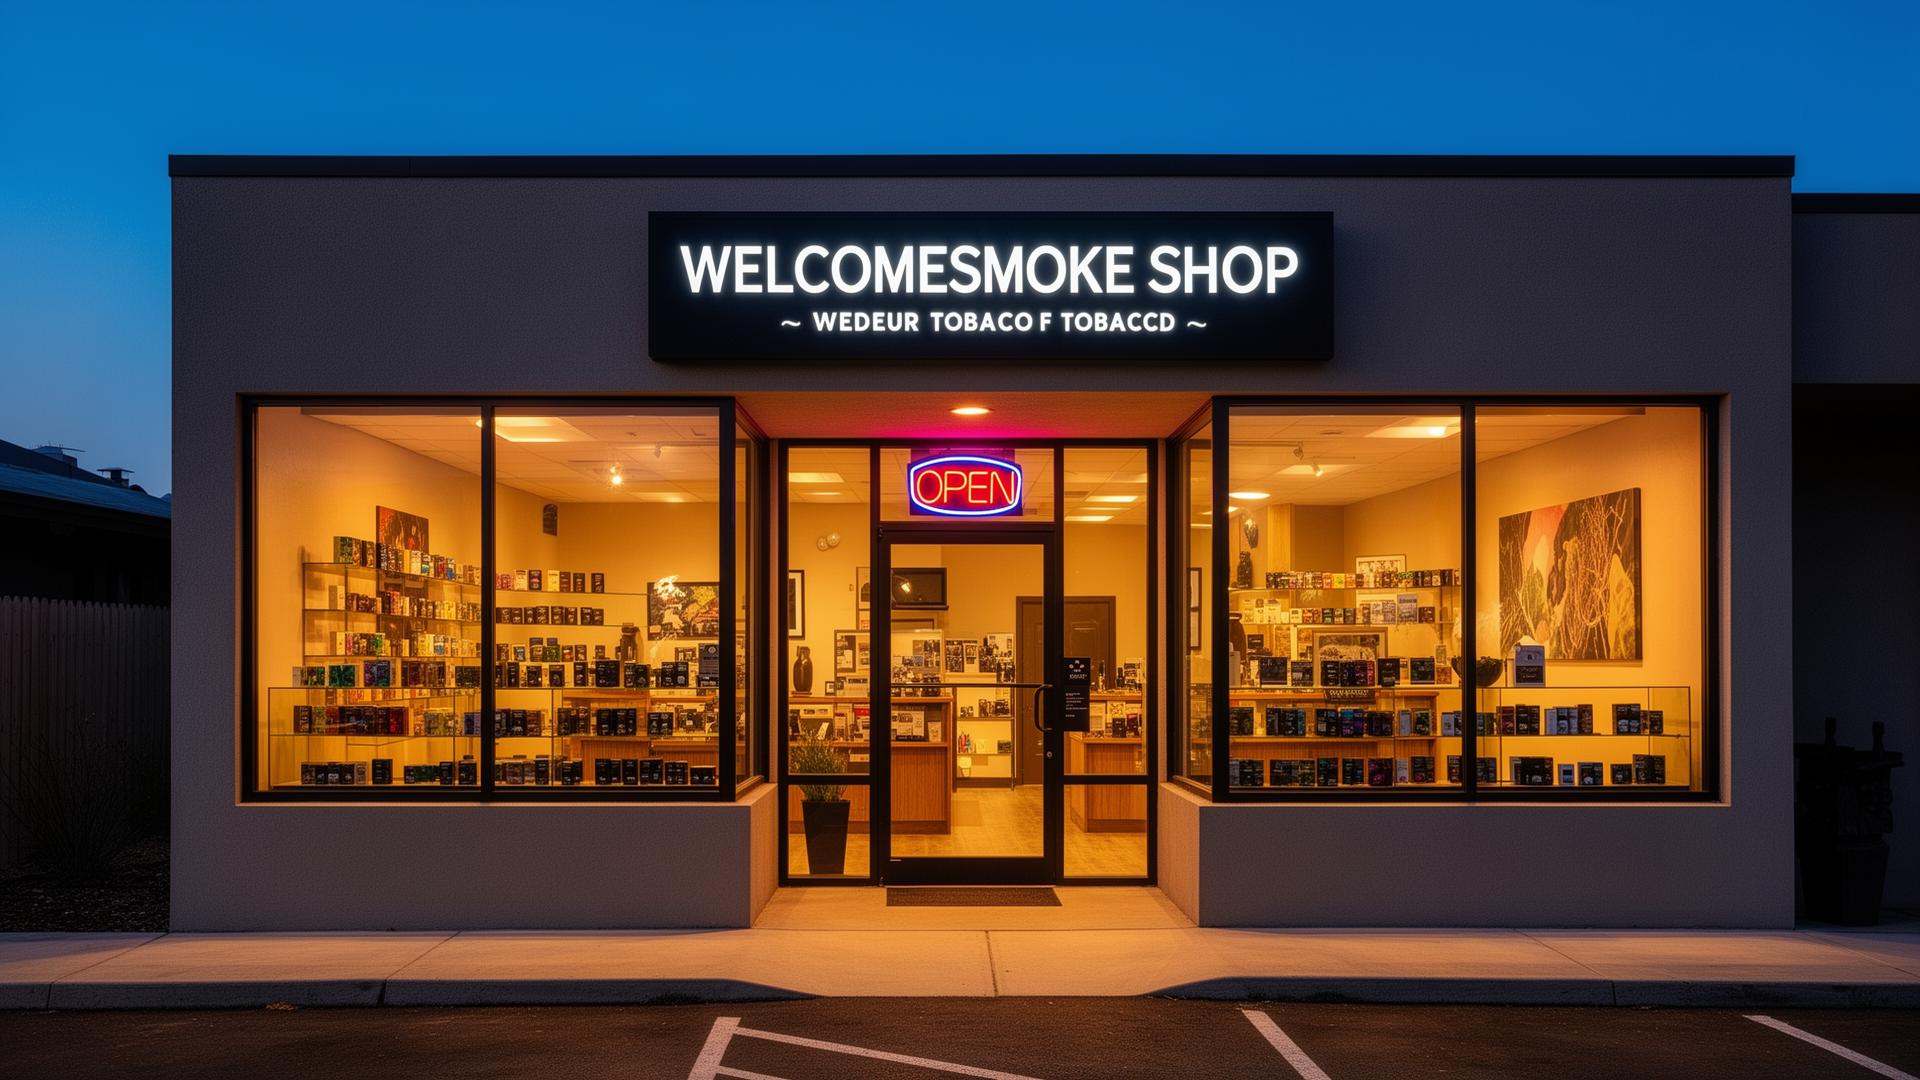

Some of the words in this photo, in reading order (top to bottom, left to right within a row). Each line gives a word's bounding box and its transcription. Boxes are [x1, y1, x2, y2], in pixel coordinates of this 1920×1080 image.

[680, 244, 1135, 294] WELCOMESMOKE
[1147, 244, 1299, 294] SHOP
[812, 311, 920, 332] WEDEUR
[1060, 311, 1176, 333] TOBACCD
[916, 470, 1015, 505] OPEN
